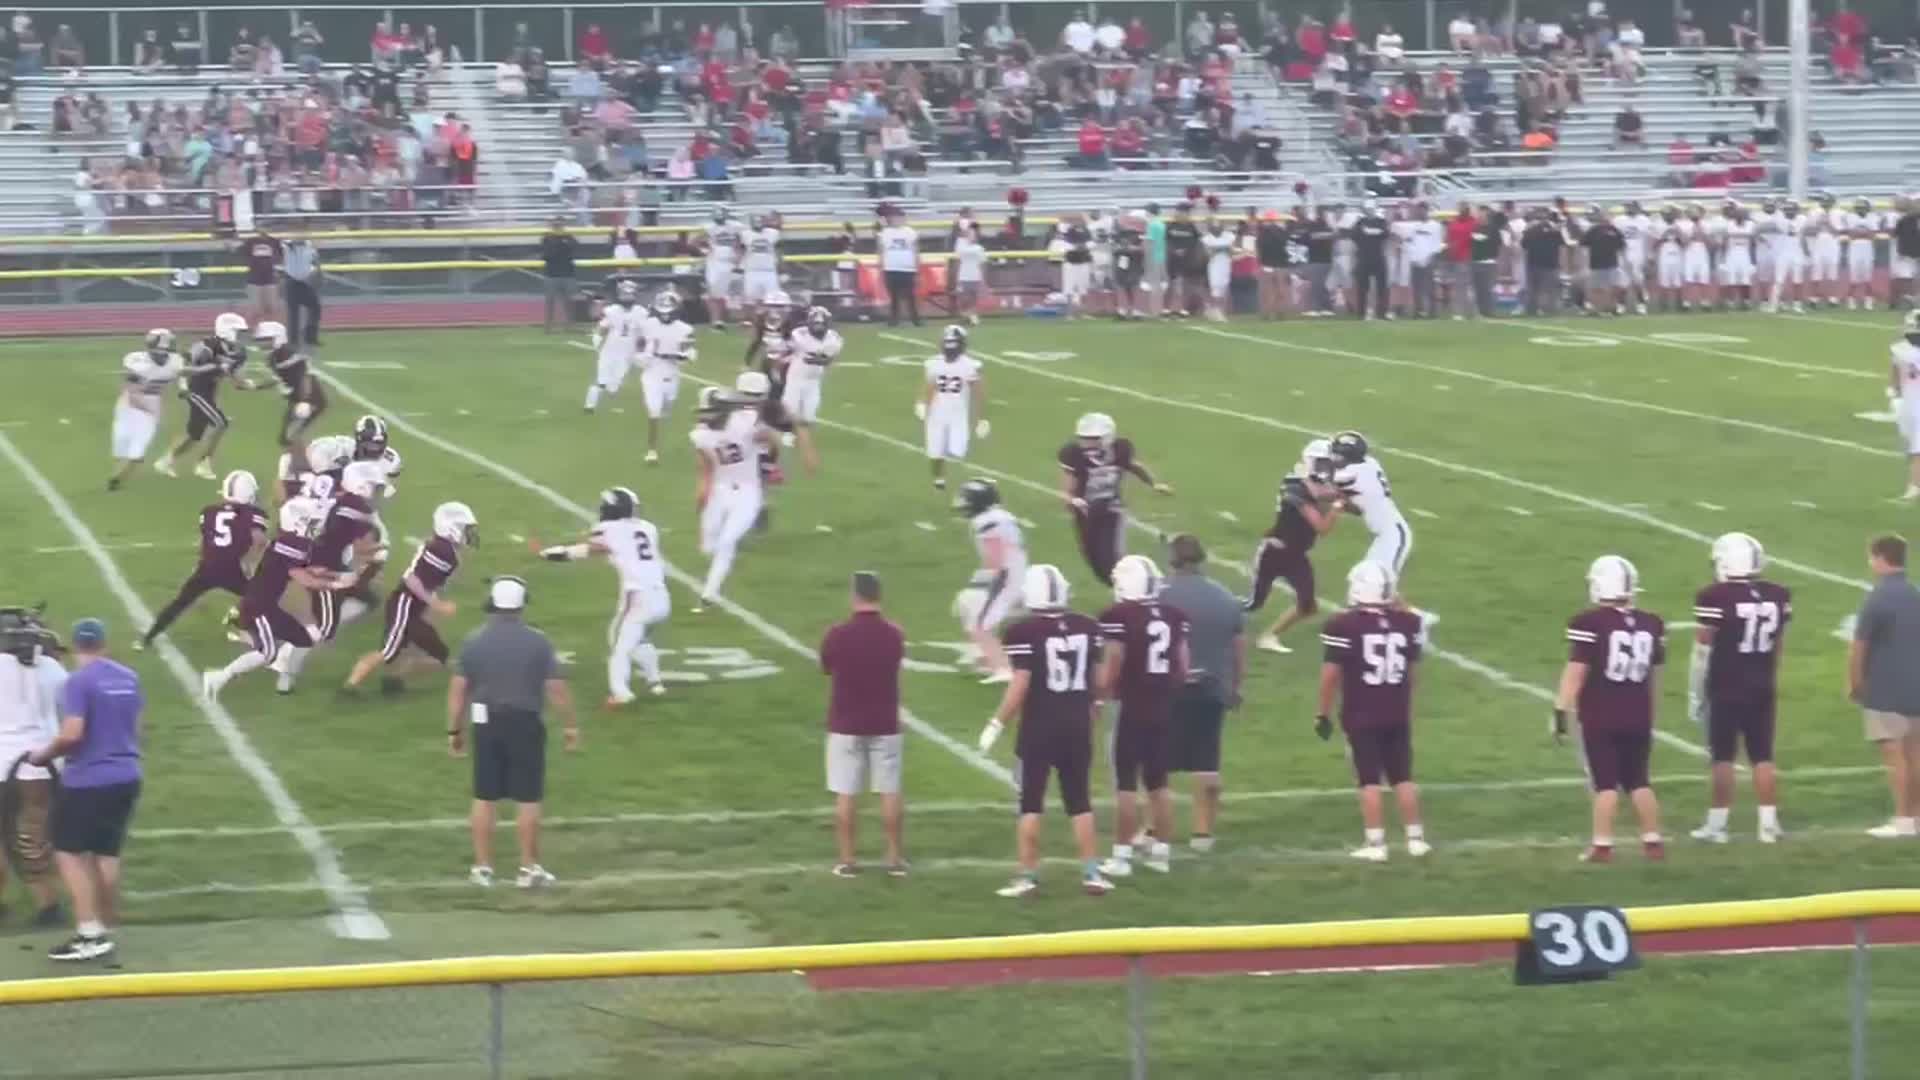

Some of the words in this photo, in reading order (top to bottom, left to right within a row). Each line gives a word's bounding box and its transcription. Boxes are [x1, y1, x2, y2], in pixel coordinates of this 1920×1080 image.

[213, 511, 238, 546] 5
[634, 530, 653, 560] 2
[1147, 620, 1171, 674] 2
[1735, 601, 1779, 653] 72
[1045, 633, 1088, 682] 67
[1362, 632, 1407, 685] 56
[1535, 910, 1628, 966] 30
